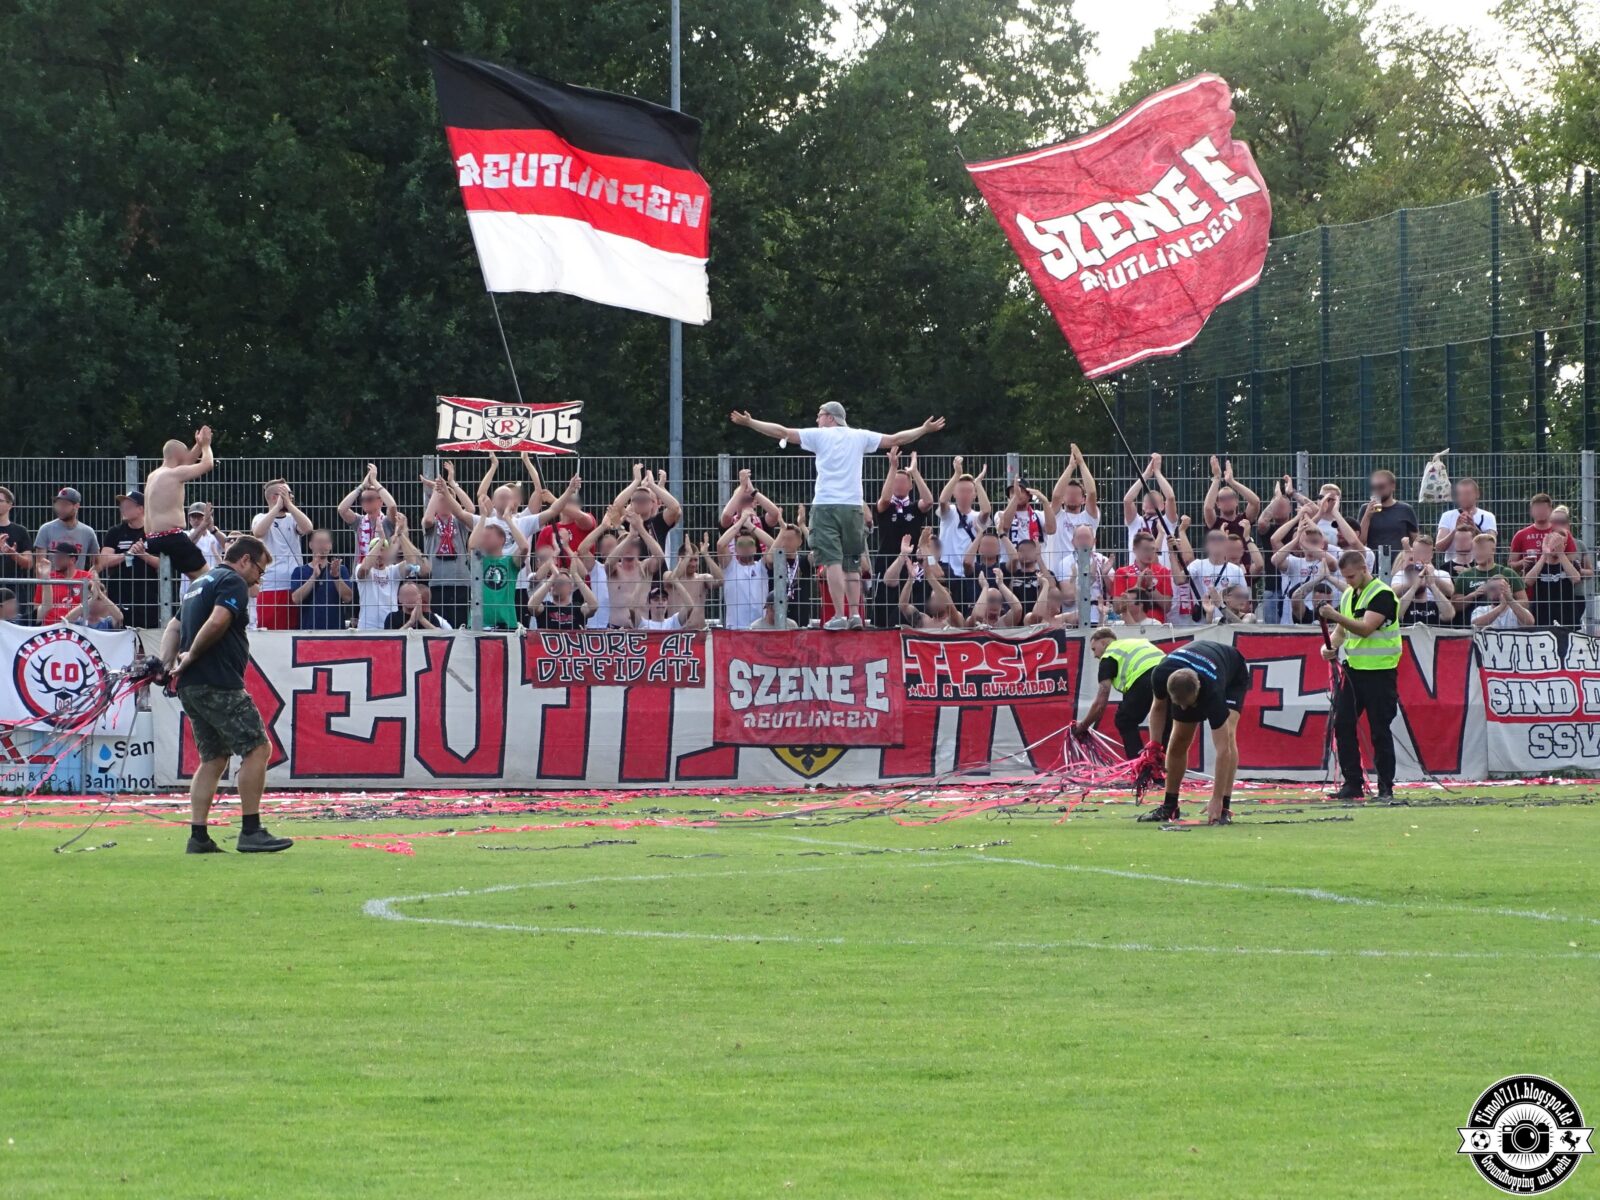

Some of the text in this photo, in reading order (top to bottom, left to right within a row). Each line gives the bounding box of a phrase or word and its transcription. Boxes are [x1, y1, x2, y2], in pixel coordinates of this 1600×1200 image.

[456, 153, 705, 228] REUTLINGEN
[1016, 136, 1261, 281] SZENE E
[487, 407, 528, 416] SSV
[500, 420, 514, 433] R
[660, 633, 695, 656] AI
[1477, 632, 1600, 671] WIR A
[51, 661, 79, 683] CO
[537, 657, 699, 682] DIFFIDATI
[906, 637, 1059, 686] TPSP
[728, 657, 890, 713] SZENE E
[917, 679, 1056, 697] NO A LA AUTORIDAD
[1487, 678, 1578, 715] SIND
[743, 711, 878, 728] REUTLINGEN
[1528, 723, 1600, 759] SSV
